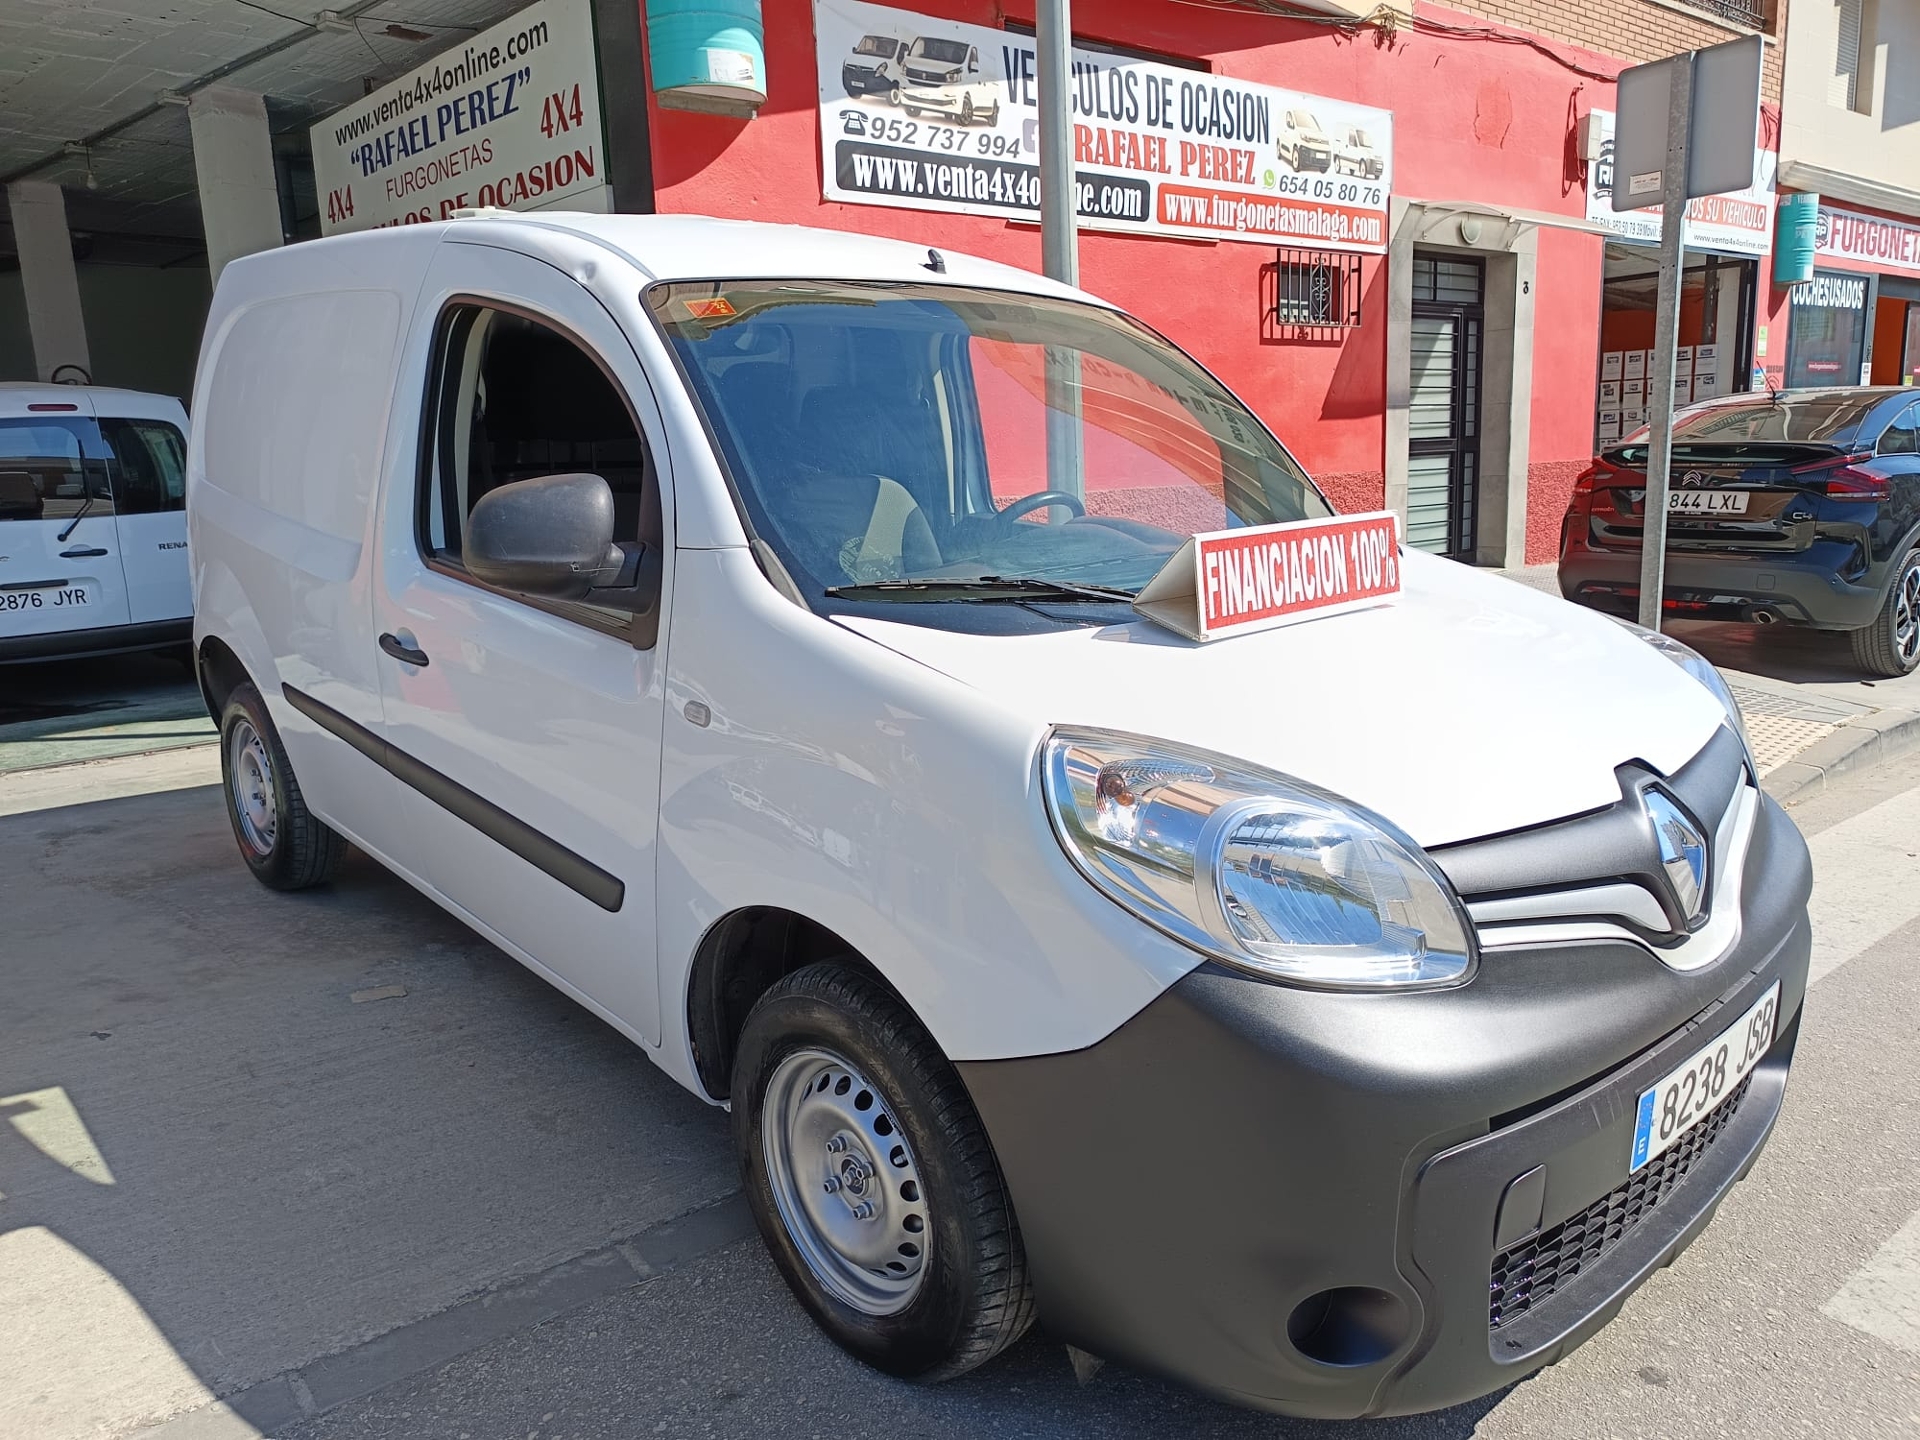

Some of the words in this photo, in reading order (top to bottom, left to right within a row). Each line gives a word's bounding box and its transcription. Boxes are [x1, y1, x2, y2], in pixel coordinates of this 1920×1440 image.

[335, 20, 549, 147] www.venta4x4online.com
[1003, 46, 1138, 125] VEULOS
[1146, 74, 1173, 130] DE
[1181, 80, 1270, 144] OCASION
[540, 83, 583, 139] 4X4
[870, 117, 918, 145] 952
[927, 126, 970, 151] 737
[977, 134, 1021, 158] 994
[1073, 124, 1172, 174] RAFAEL
[1179, 140, 1256, 185] PEREZ
[386, 138, 493, 202] FURGONETAS
[478, 146, 595, 208] OCASION
[1279, 175, 1308, 196] 654
[1313, 180, 1333, 199] 05
[1338, 183, 1357, 202] 80
[1363, 187, 1381, 205] 76
[327, 183, 354, 225] 4X4
[1165, 192, 1381, 241] www.furgonetasmalaga.com
[1706, 199, 1721, 222] SU
[1723, 202, 1766, 229] VEHICULO
[1830, 213, 1920, 263] FURGONET
[1669, 493, 1701, 509] 844
[1708, 494, 1742, 510] LXL
[1793, 512, 1812, 520] C4
[158, 541, 188, 551] RENA
[1205, 533, 1348, 620] FINANCIACION
[1351, 527, 1396, 590] 100%
[0, 592, 43, 612] 2876
[53, 589, 87, 607] JYR
[1660, 1044, 1729, 1140] 8238
[1737, 997, 1774, 1075] JSB
